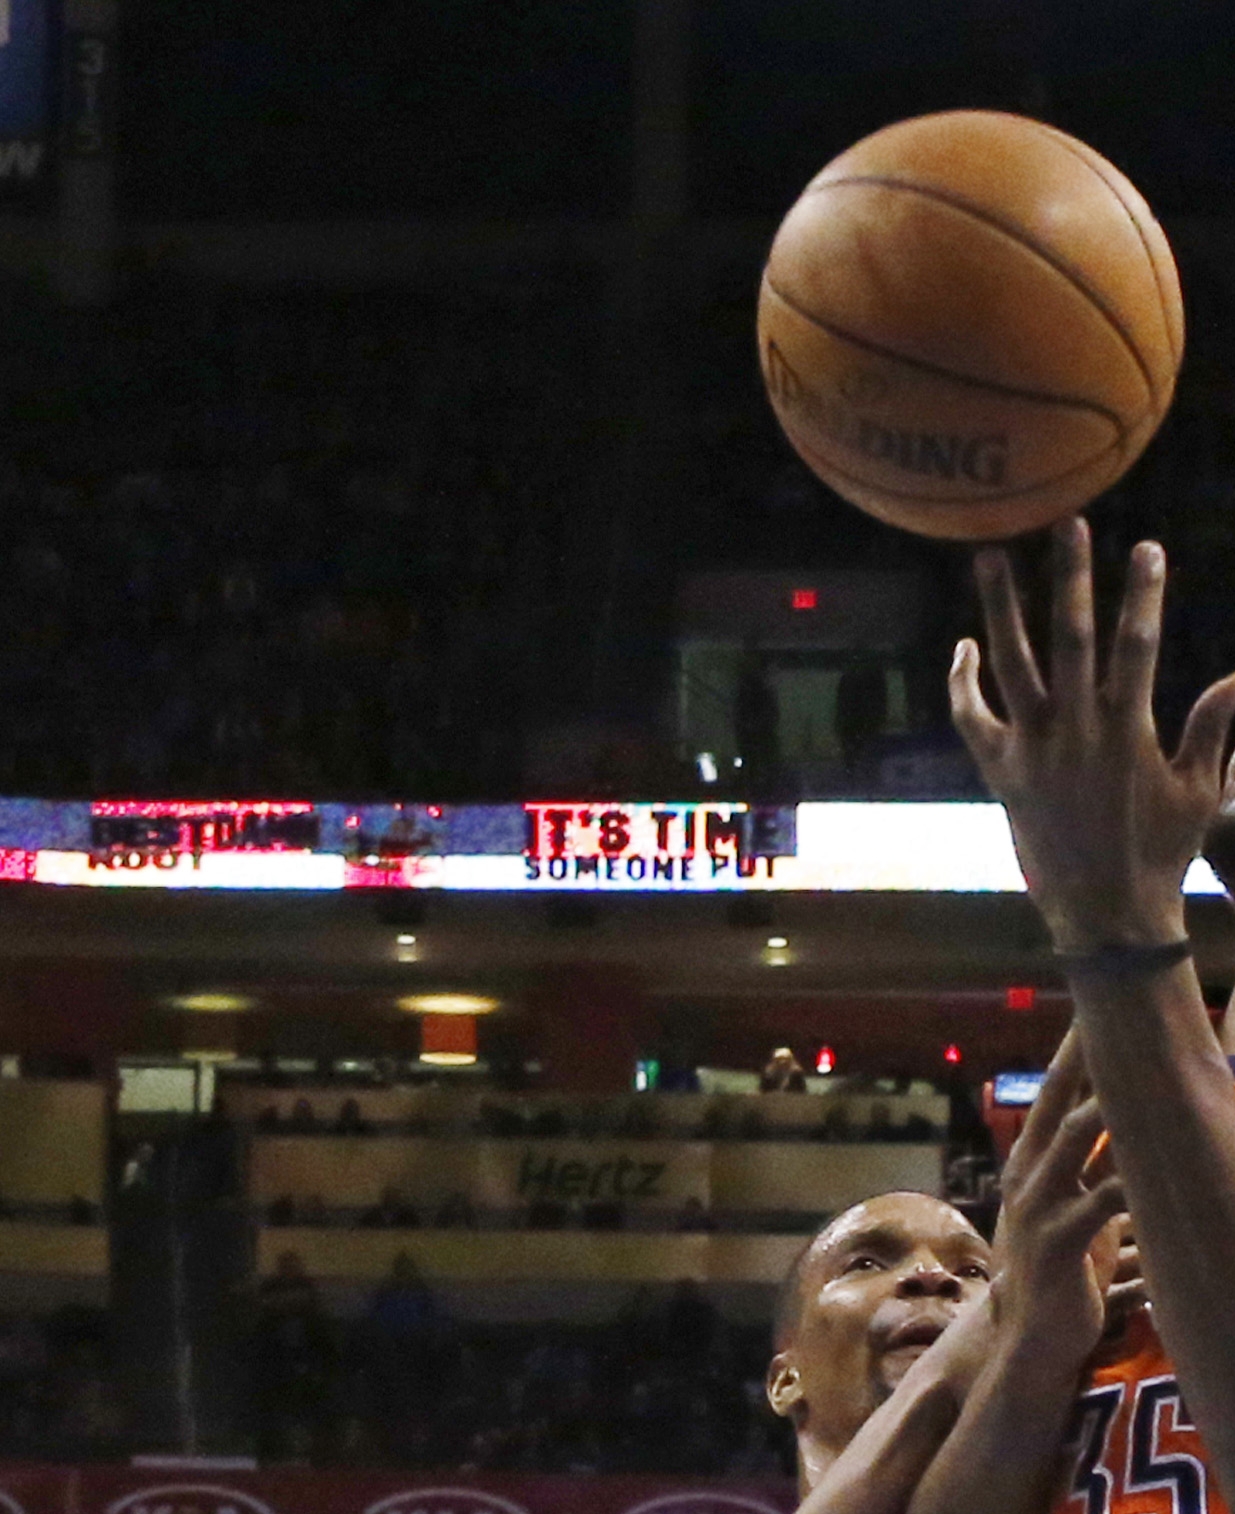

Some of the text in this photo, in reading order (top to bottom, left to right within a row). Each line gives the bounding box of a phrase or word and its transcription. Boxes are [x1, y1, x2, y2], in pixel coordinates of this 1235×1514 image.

[526, 856, 775, 880] SOMEONE PUT
[516, 1147, 667, 1197] Hertz
